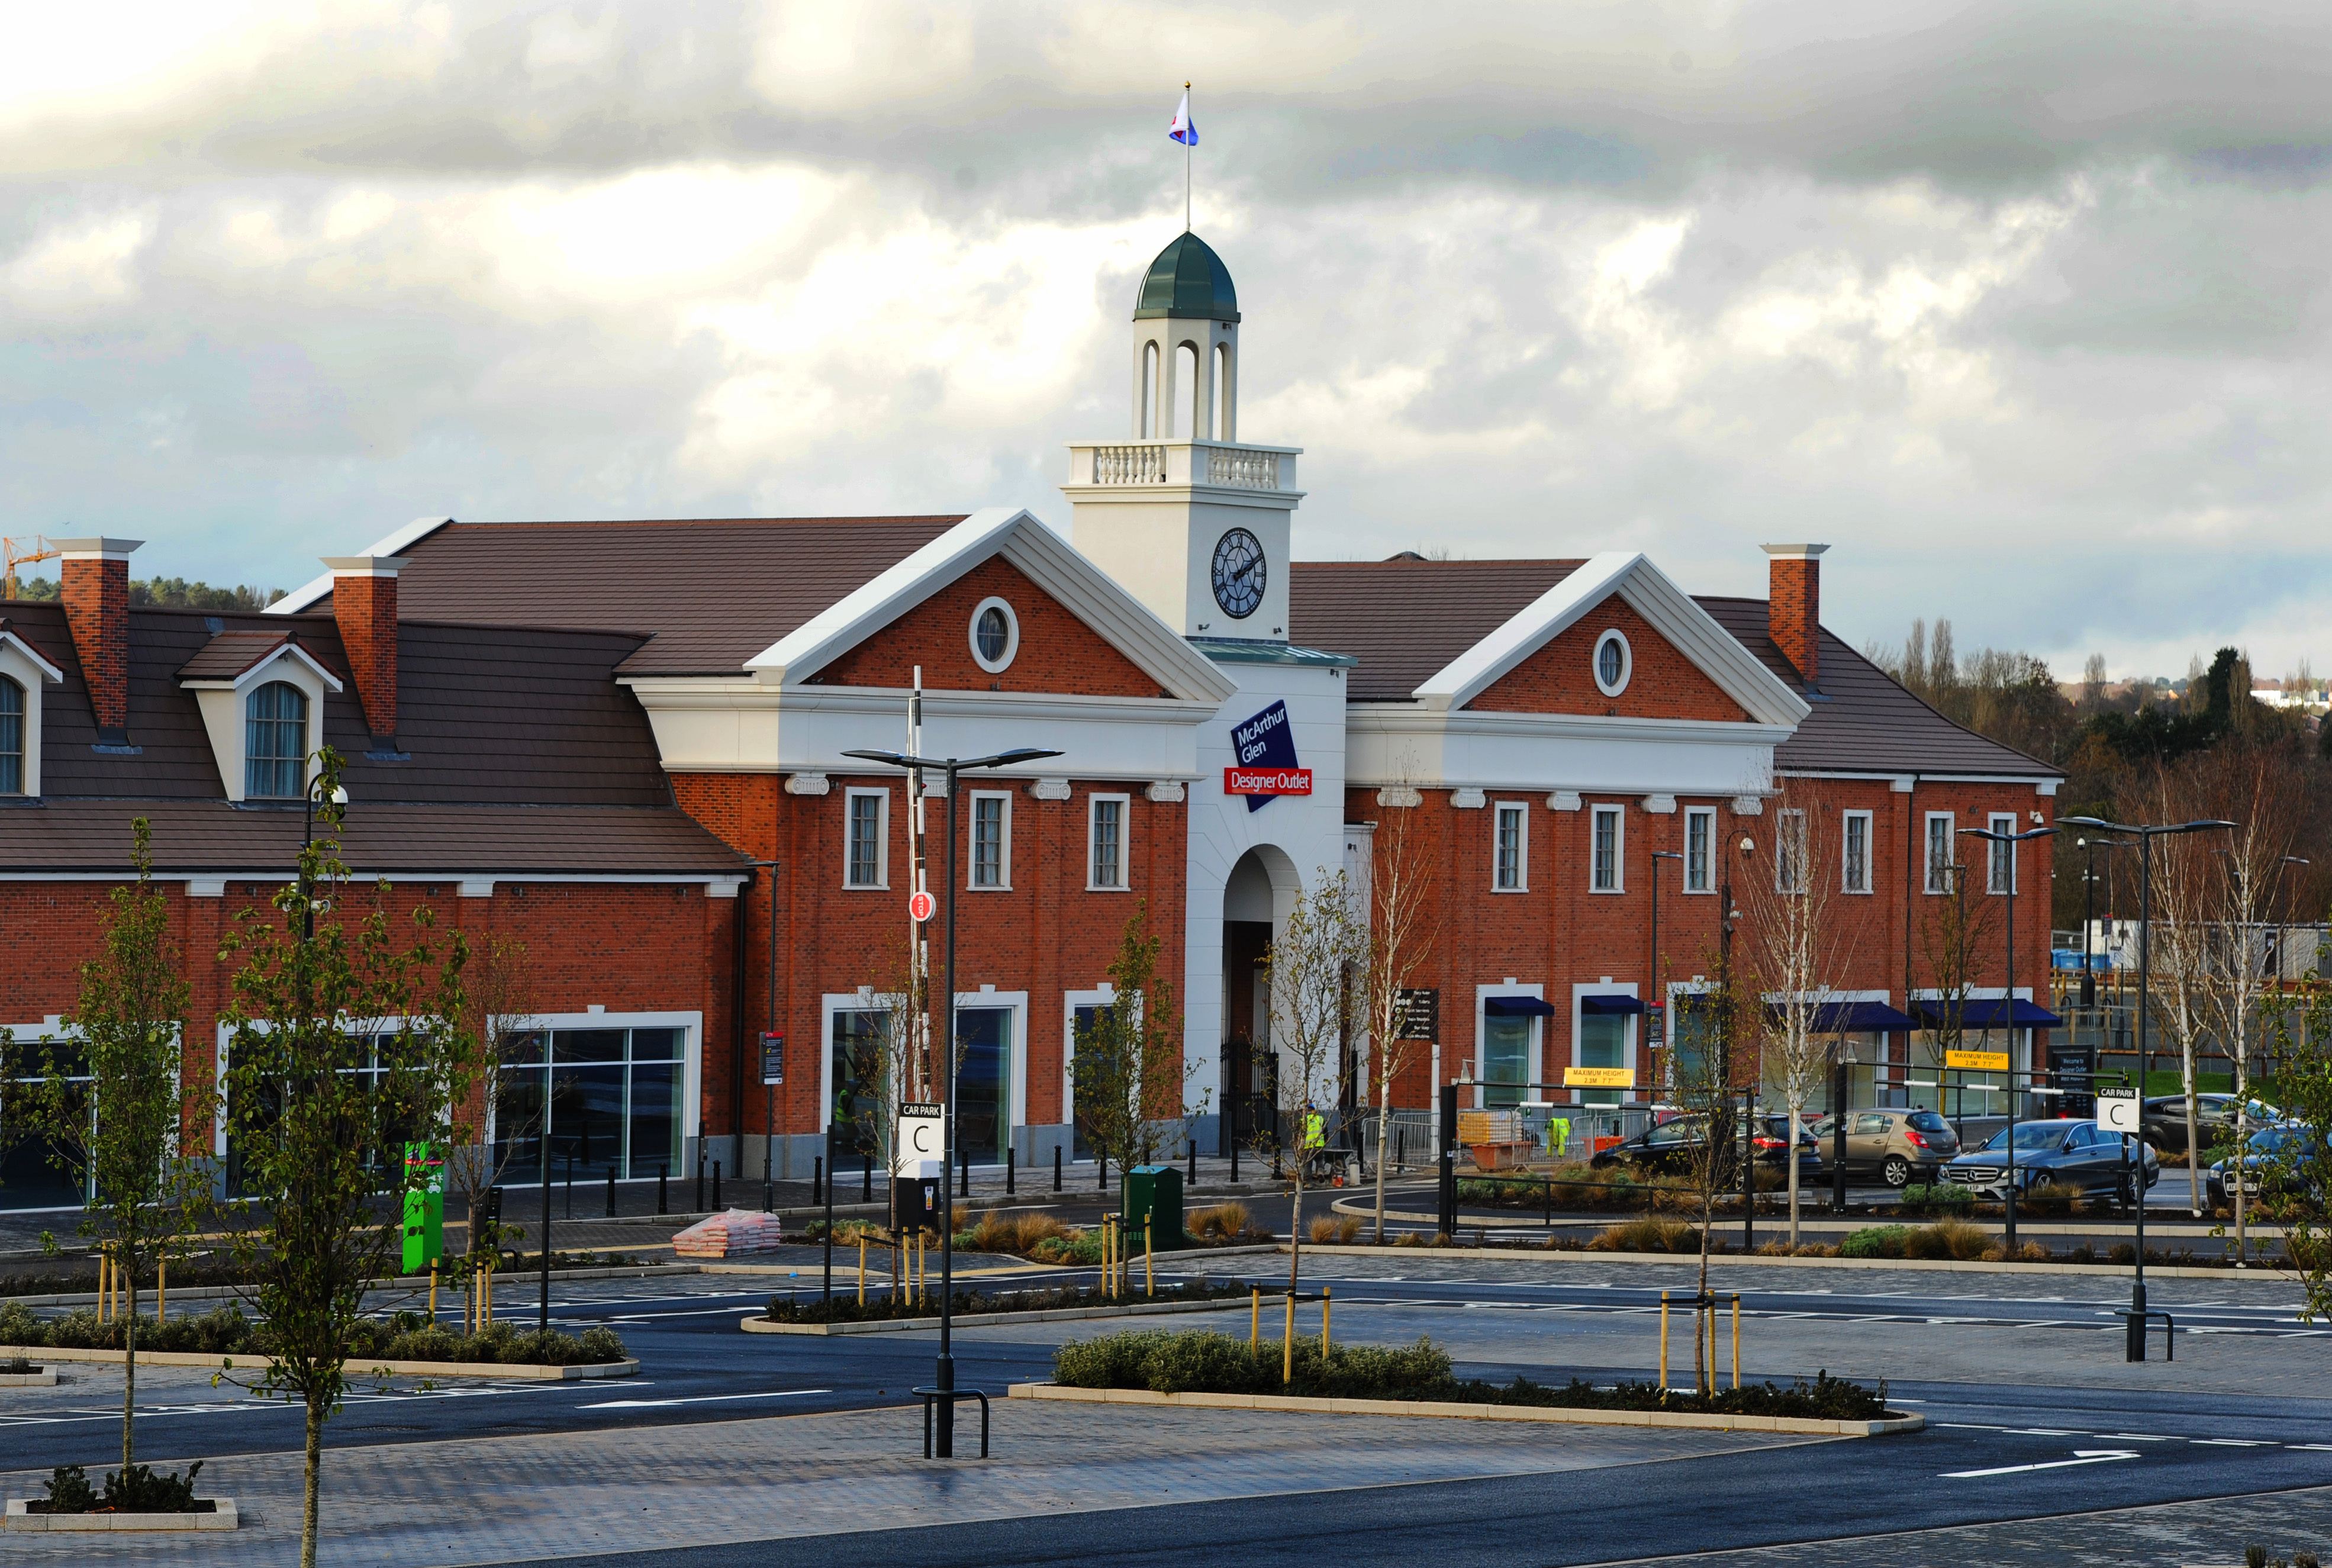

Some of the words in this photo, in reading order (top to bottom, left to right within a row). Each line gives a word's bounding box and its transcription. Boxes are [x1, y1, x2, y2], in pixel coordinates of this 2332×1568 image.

[1238, 708, 1284, 746] McArthur
[1242, 741, 1267, 763] Glen
[1232, 772, 1277, 793] Designer
[1277, 772, 1309, 789] Outlet
[2101, 1088, 2115, 1097] CAR
[2116, 1089, 2133, 1097] PARK
[903, 1105, 919, 1115] CAR
[920, 1106, 939, 1116] PARK
[2110, 1104, 2124, 1125] C
[913, 1125, 929, 1152] C
